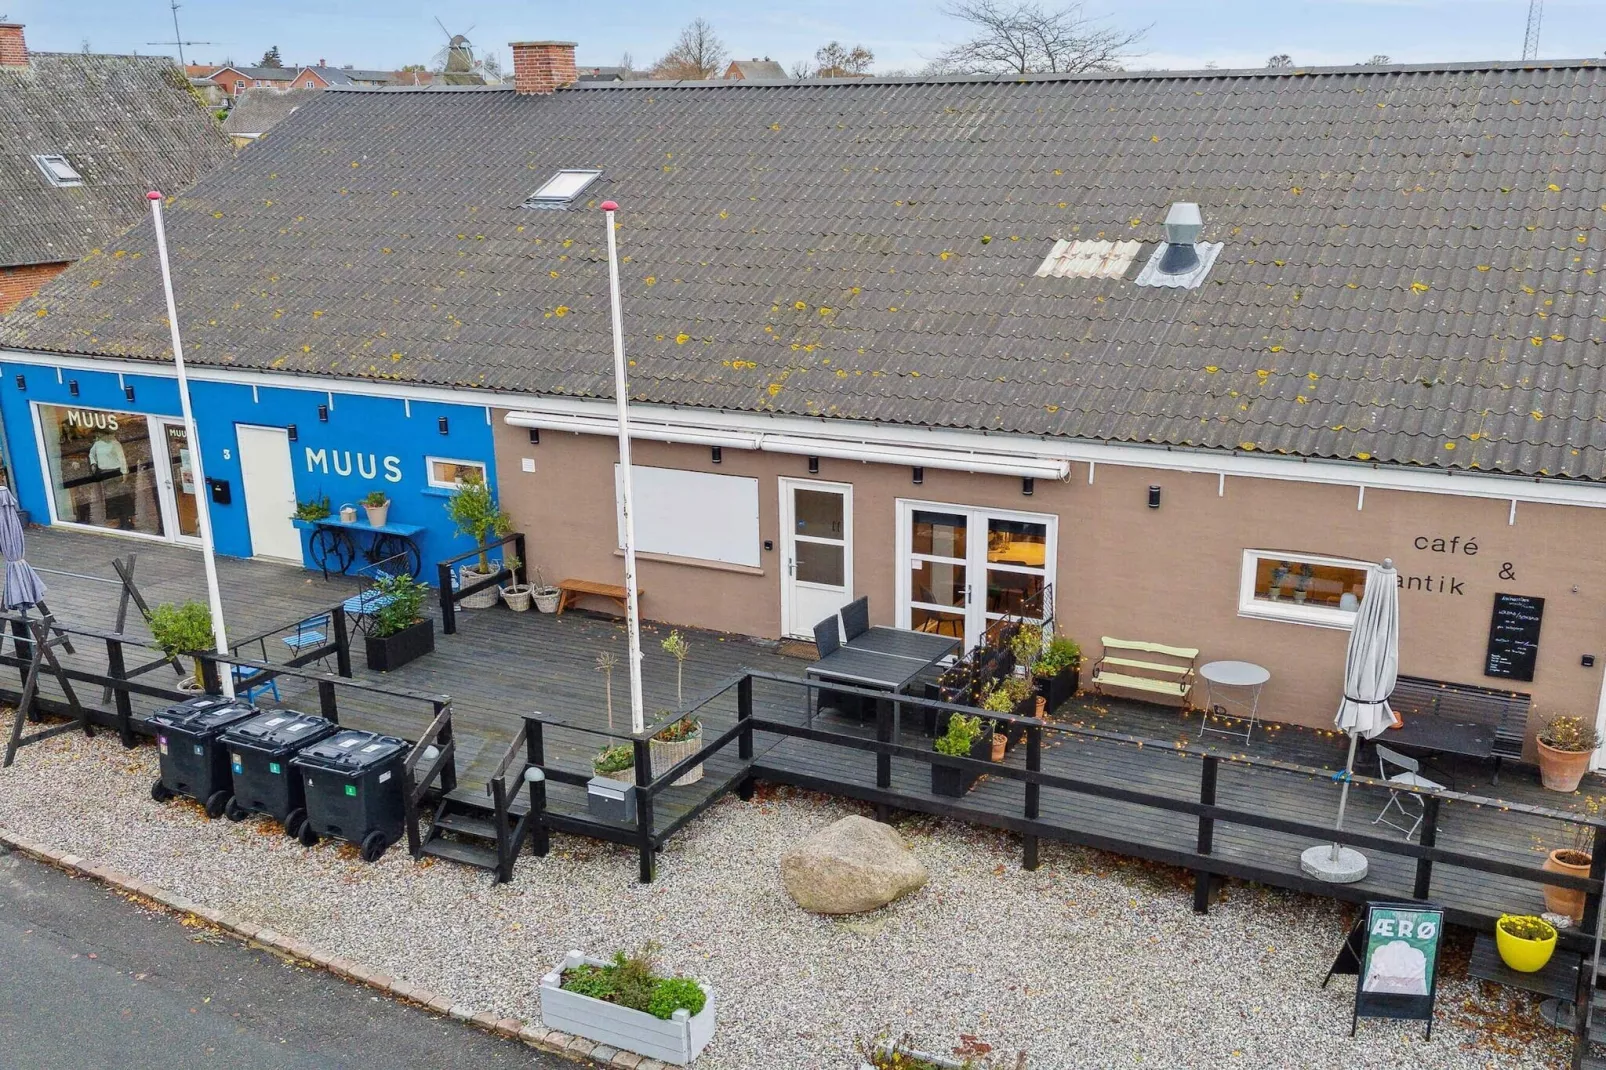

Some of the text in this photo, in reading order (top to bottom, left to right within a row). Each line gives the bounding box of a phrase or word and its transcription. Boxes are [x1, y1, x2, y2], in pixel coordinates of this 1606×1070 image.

[67, 410, 119, 431] MUUS
[169, 429, 187, 438] MUU
[305, 447, 403, 483] MUUS
[1414, 536, 1479, 556] café
[1498, 561, 1517, 581] &
[1371, 918, 1436, 939] ÆRØ
